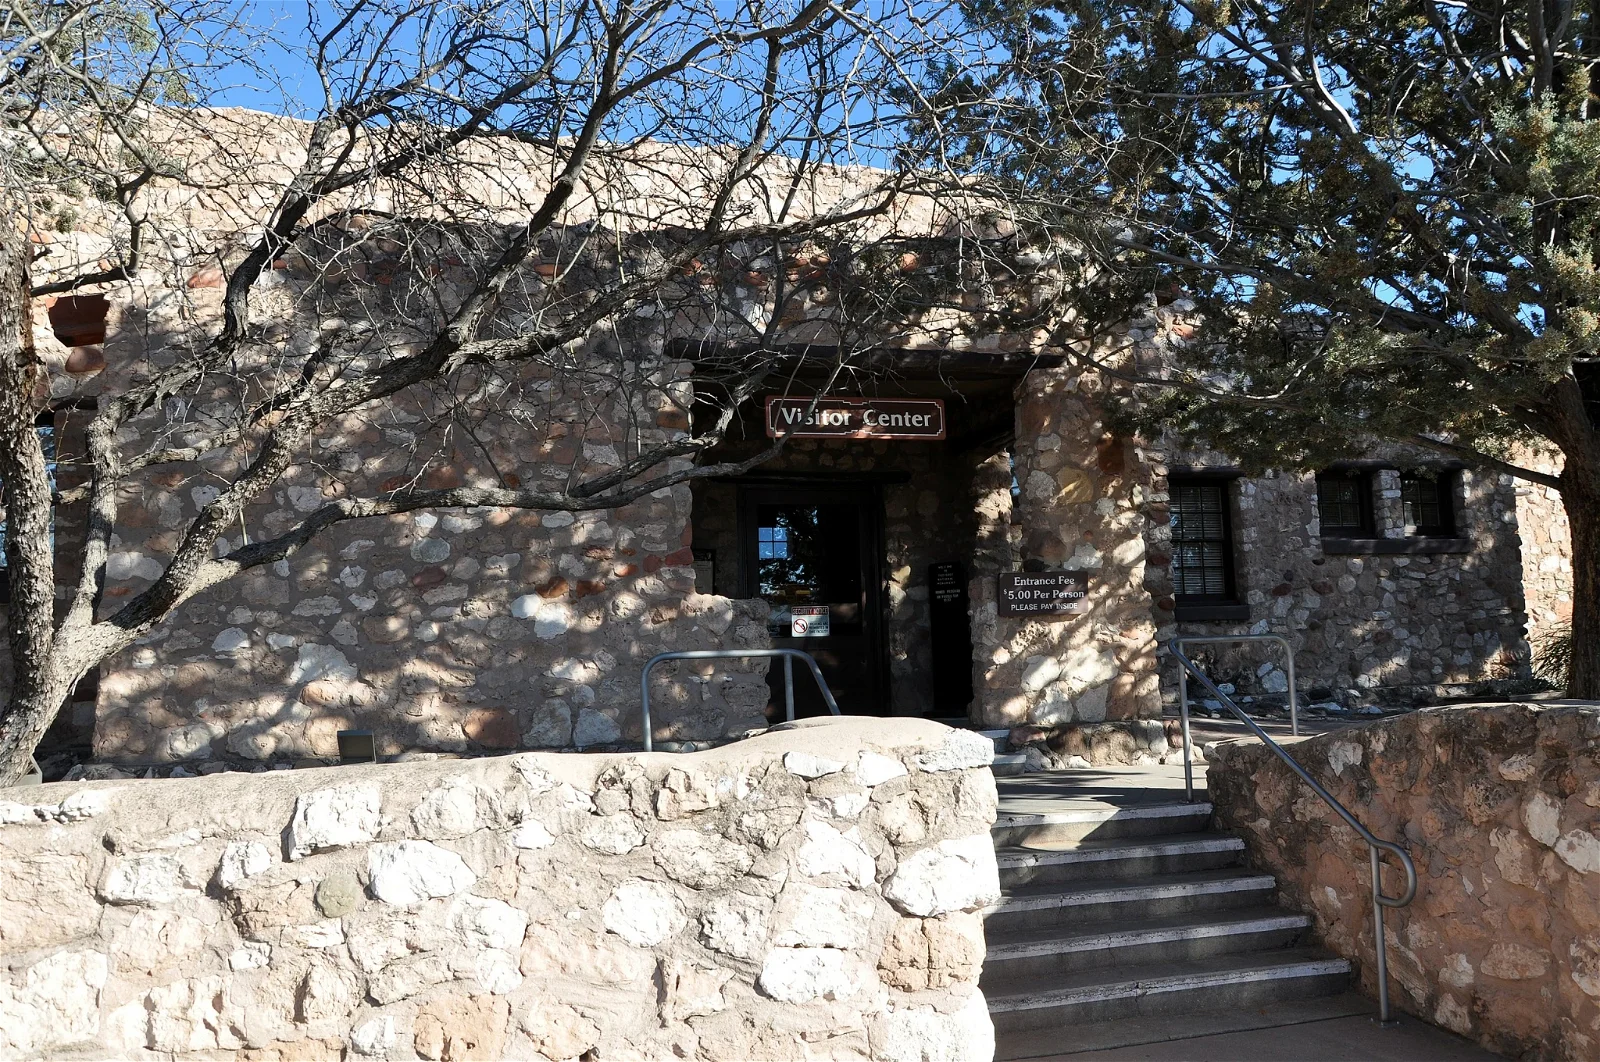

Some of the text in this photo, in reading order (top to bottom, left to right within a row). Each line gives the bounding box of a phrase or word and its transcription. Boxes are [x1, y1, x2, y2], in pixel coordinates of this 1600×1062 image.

[781, 407, 932, 427] Visitor Center
[1014, 575, 1075, 586] Entrance Fee
[1003, 588, 1085, 600] $5.00 Per Person
[1011, 603, 1038, 611] PLEASE
